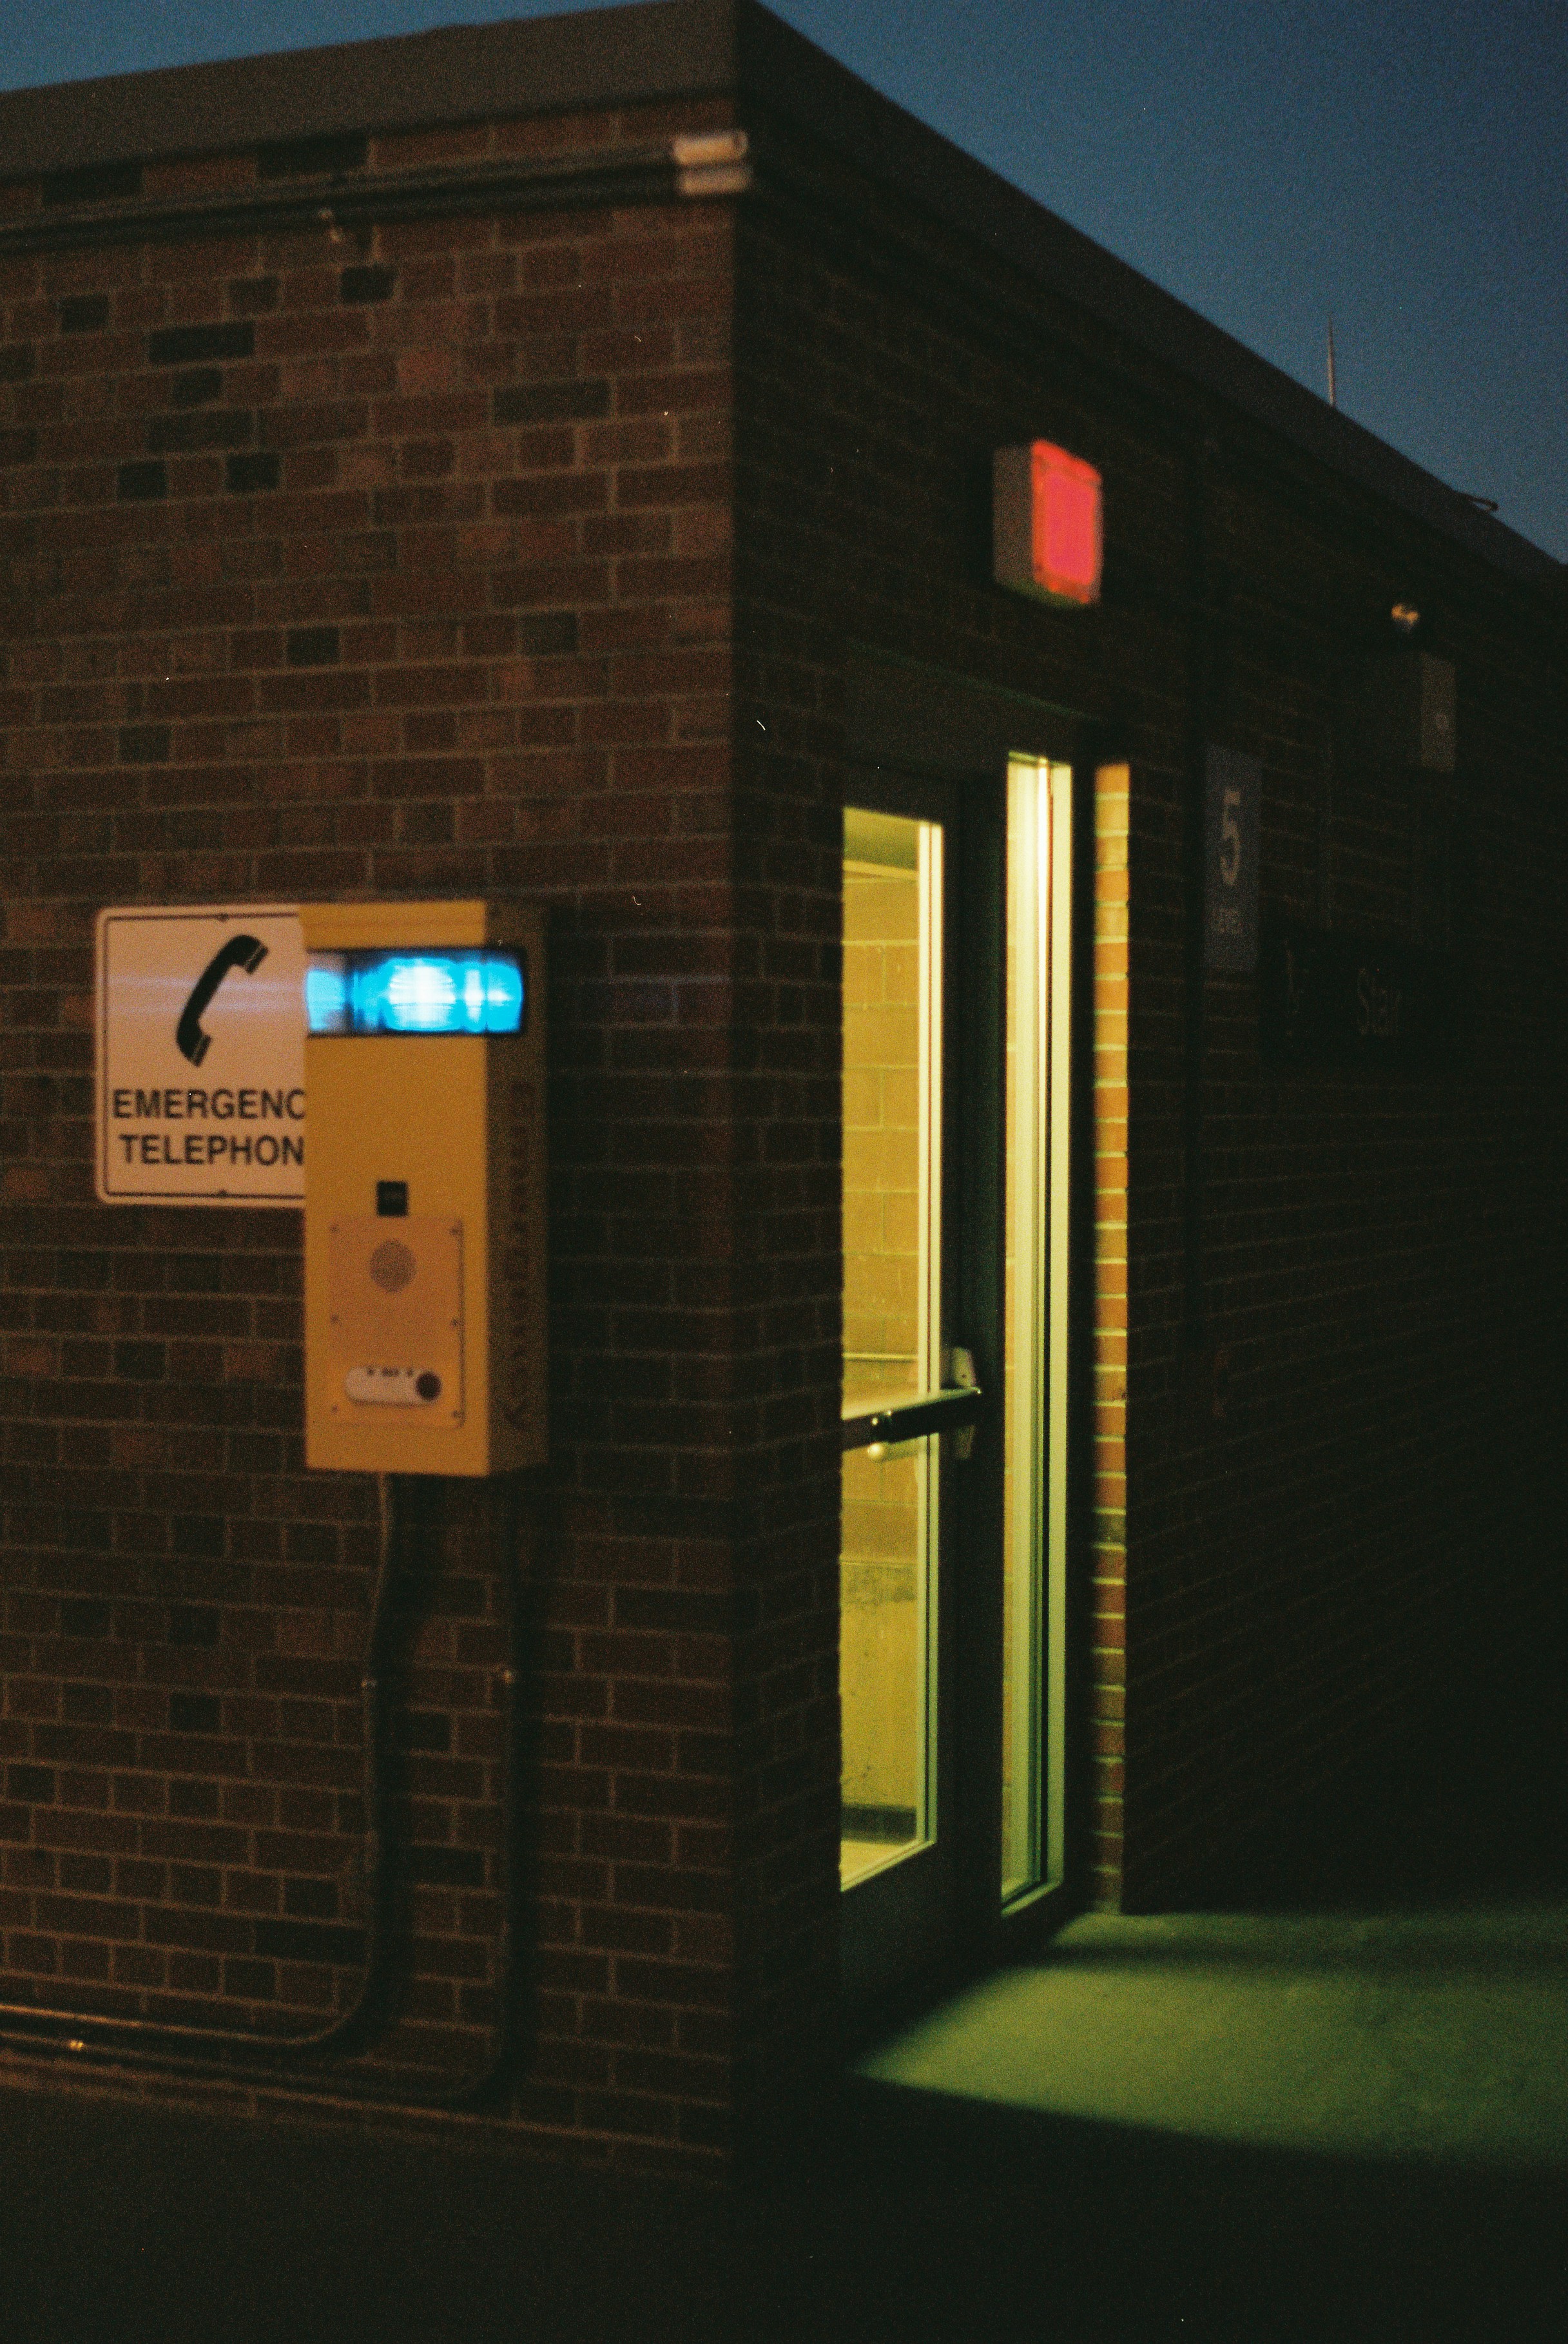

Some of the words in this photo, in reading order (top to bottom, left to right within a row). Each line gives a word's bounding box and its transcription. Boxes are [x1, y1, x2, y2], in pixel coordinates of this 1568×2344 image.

[1219, 787, 1242, 887] 5
[113, 1088, 306, 1120] EMERGENC
[118, 1134, 304, 1166] TELEPHON
